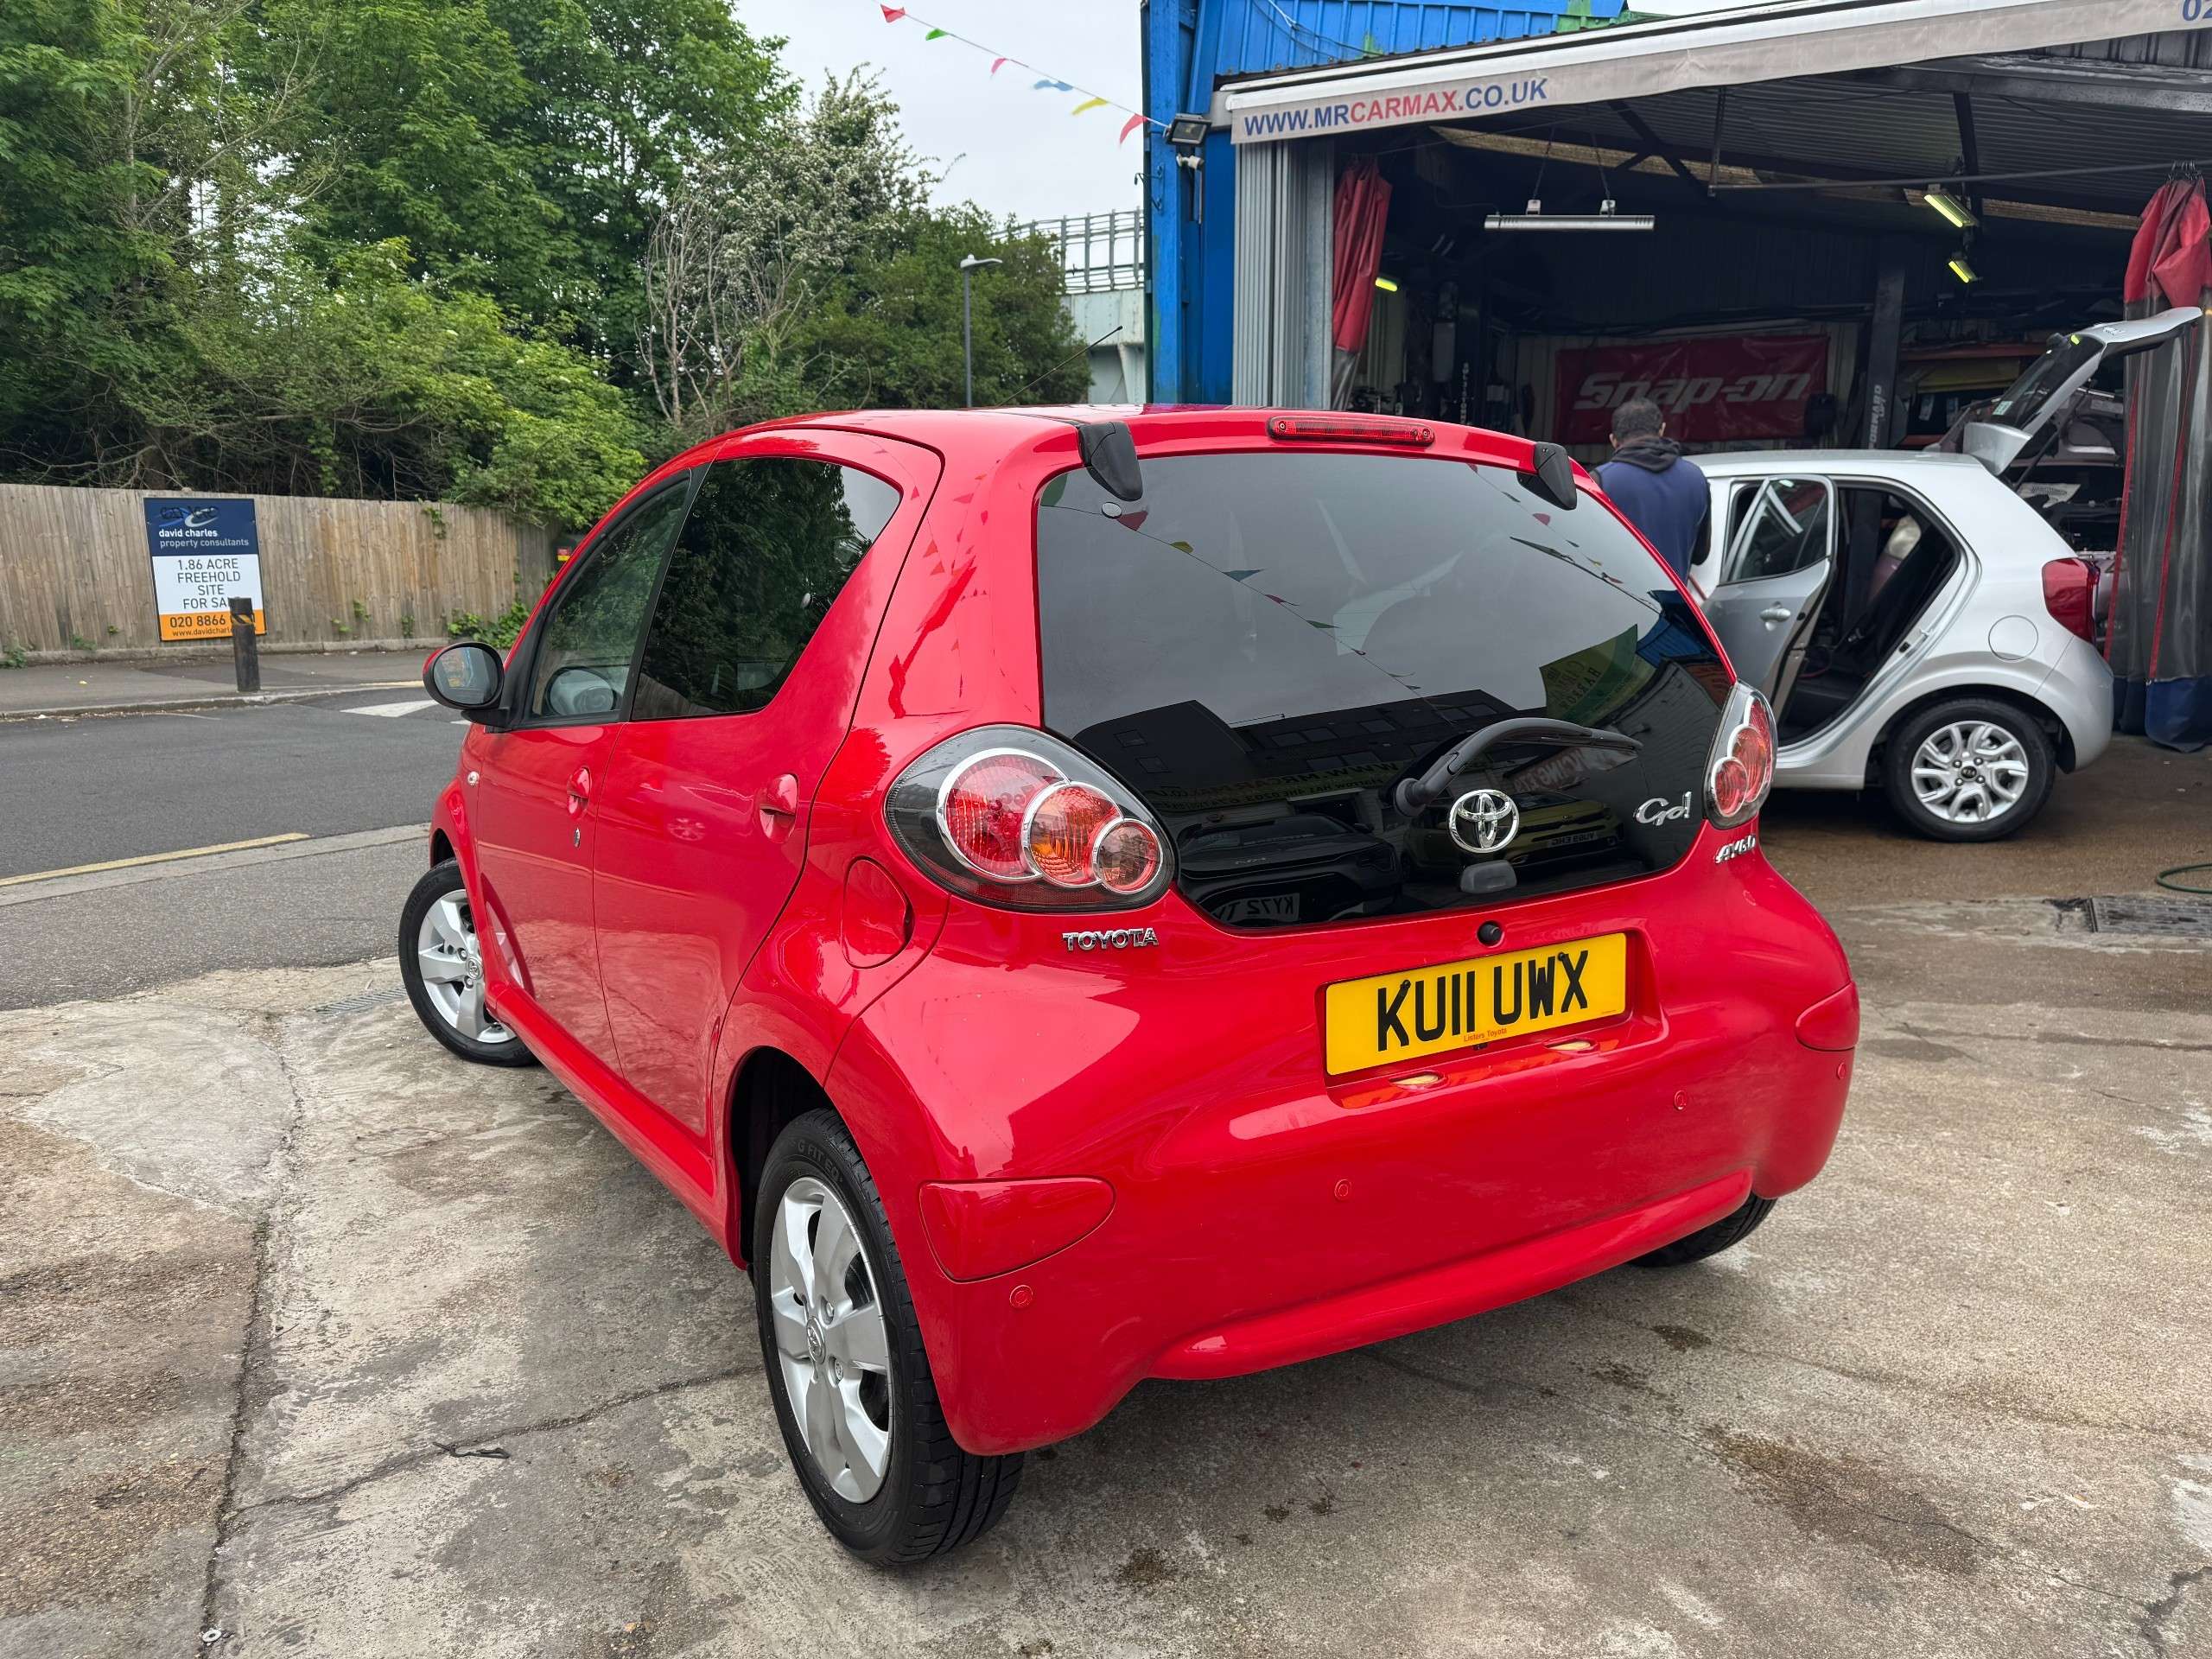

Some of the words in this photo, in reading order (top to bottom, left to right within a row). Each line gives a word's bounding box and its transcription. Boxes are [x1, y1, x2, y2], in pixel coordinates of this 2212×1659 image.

[1244, 78, 1548, 137] WWW.MRCARMAX.CO.UK
[1573, 372, 1811, 415] Snap-on
[159, 529, 183, 537] david
[185, 528, 218, 537] charles
[160, 539, 198, 550] property
[200, 538, 250, 547] consultants
[178, 559, 203, 570] 1.86
[207, 558, 238, 569] ACRE
[178, 571, 241, 583] FREEHOLD
[198, 584, 225, 596] SITE
[183, 598, 207, 609] FOR
[212, 597, 229, 608] SA
[169, 616, 193, 628] 020
[196, 614, 226, 626] 8866
[1063, 927, 1159, 950] TOYOTA
[1377, 970, 1476, 1052] KU11
[1494, 950, 1589, 1026] UWX
